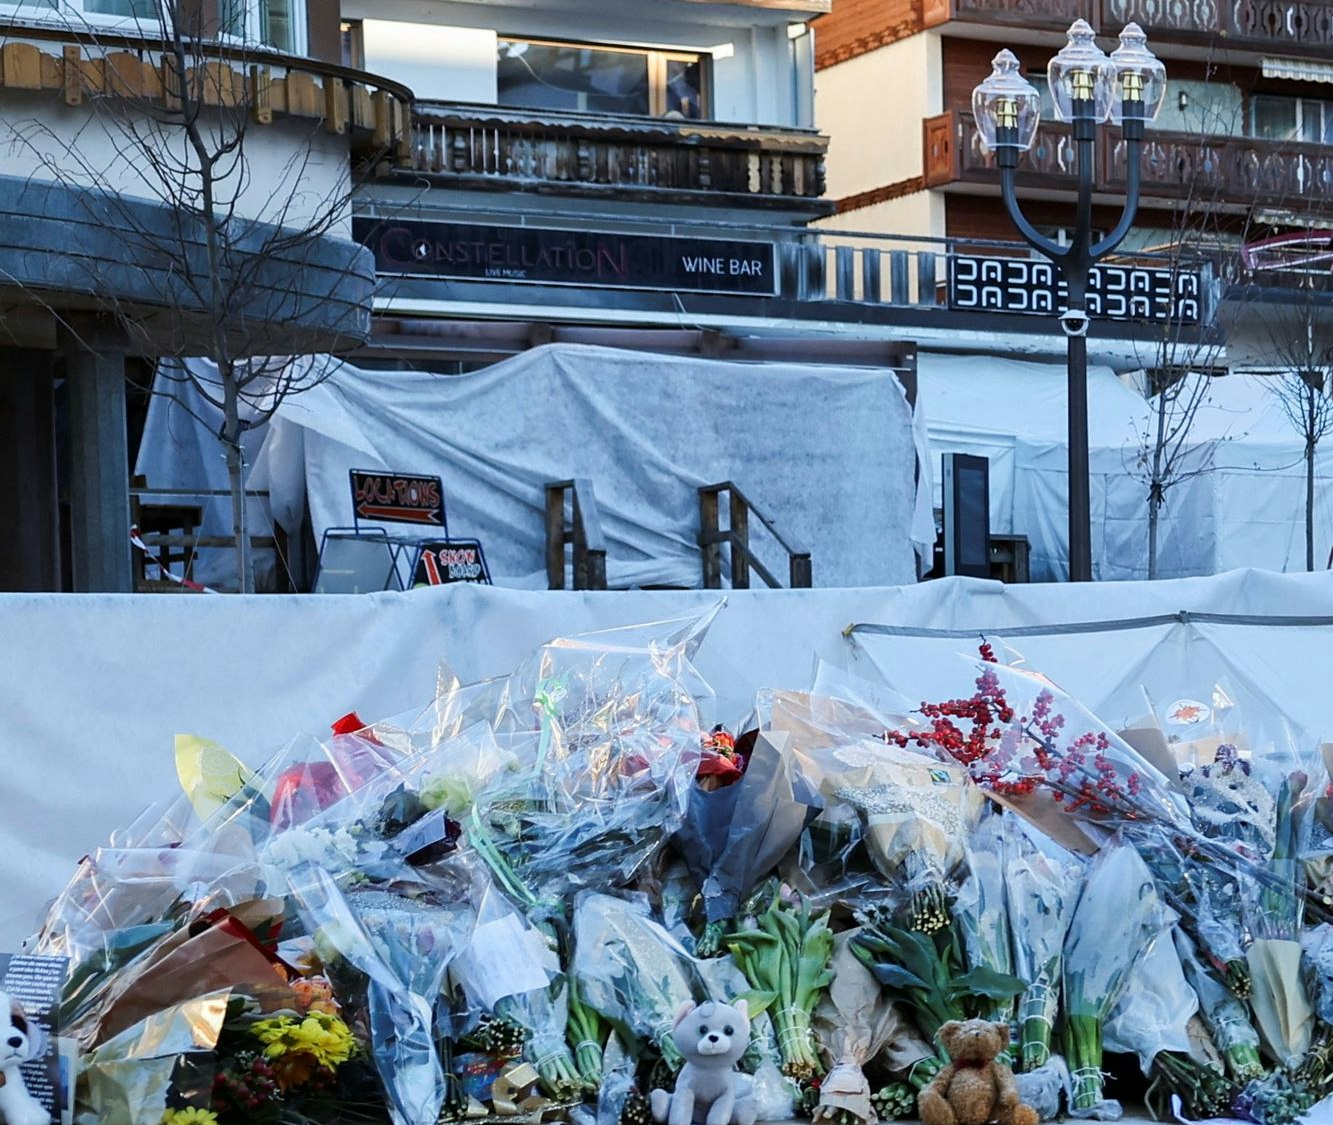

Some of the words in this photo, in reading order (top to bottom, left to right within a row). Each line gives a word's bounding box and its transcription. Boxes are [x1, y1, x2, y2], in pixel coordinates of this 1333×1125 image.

[485, 268, 501, 277] LIVE
[503, 268, 526, 278] MUSIC
[682, 255, 726, 275] WINE
[729, 258, 762, 276] BAR
[354, 475, 441, 508] LOCATIONS
